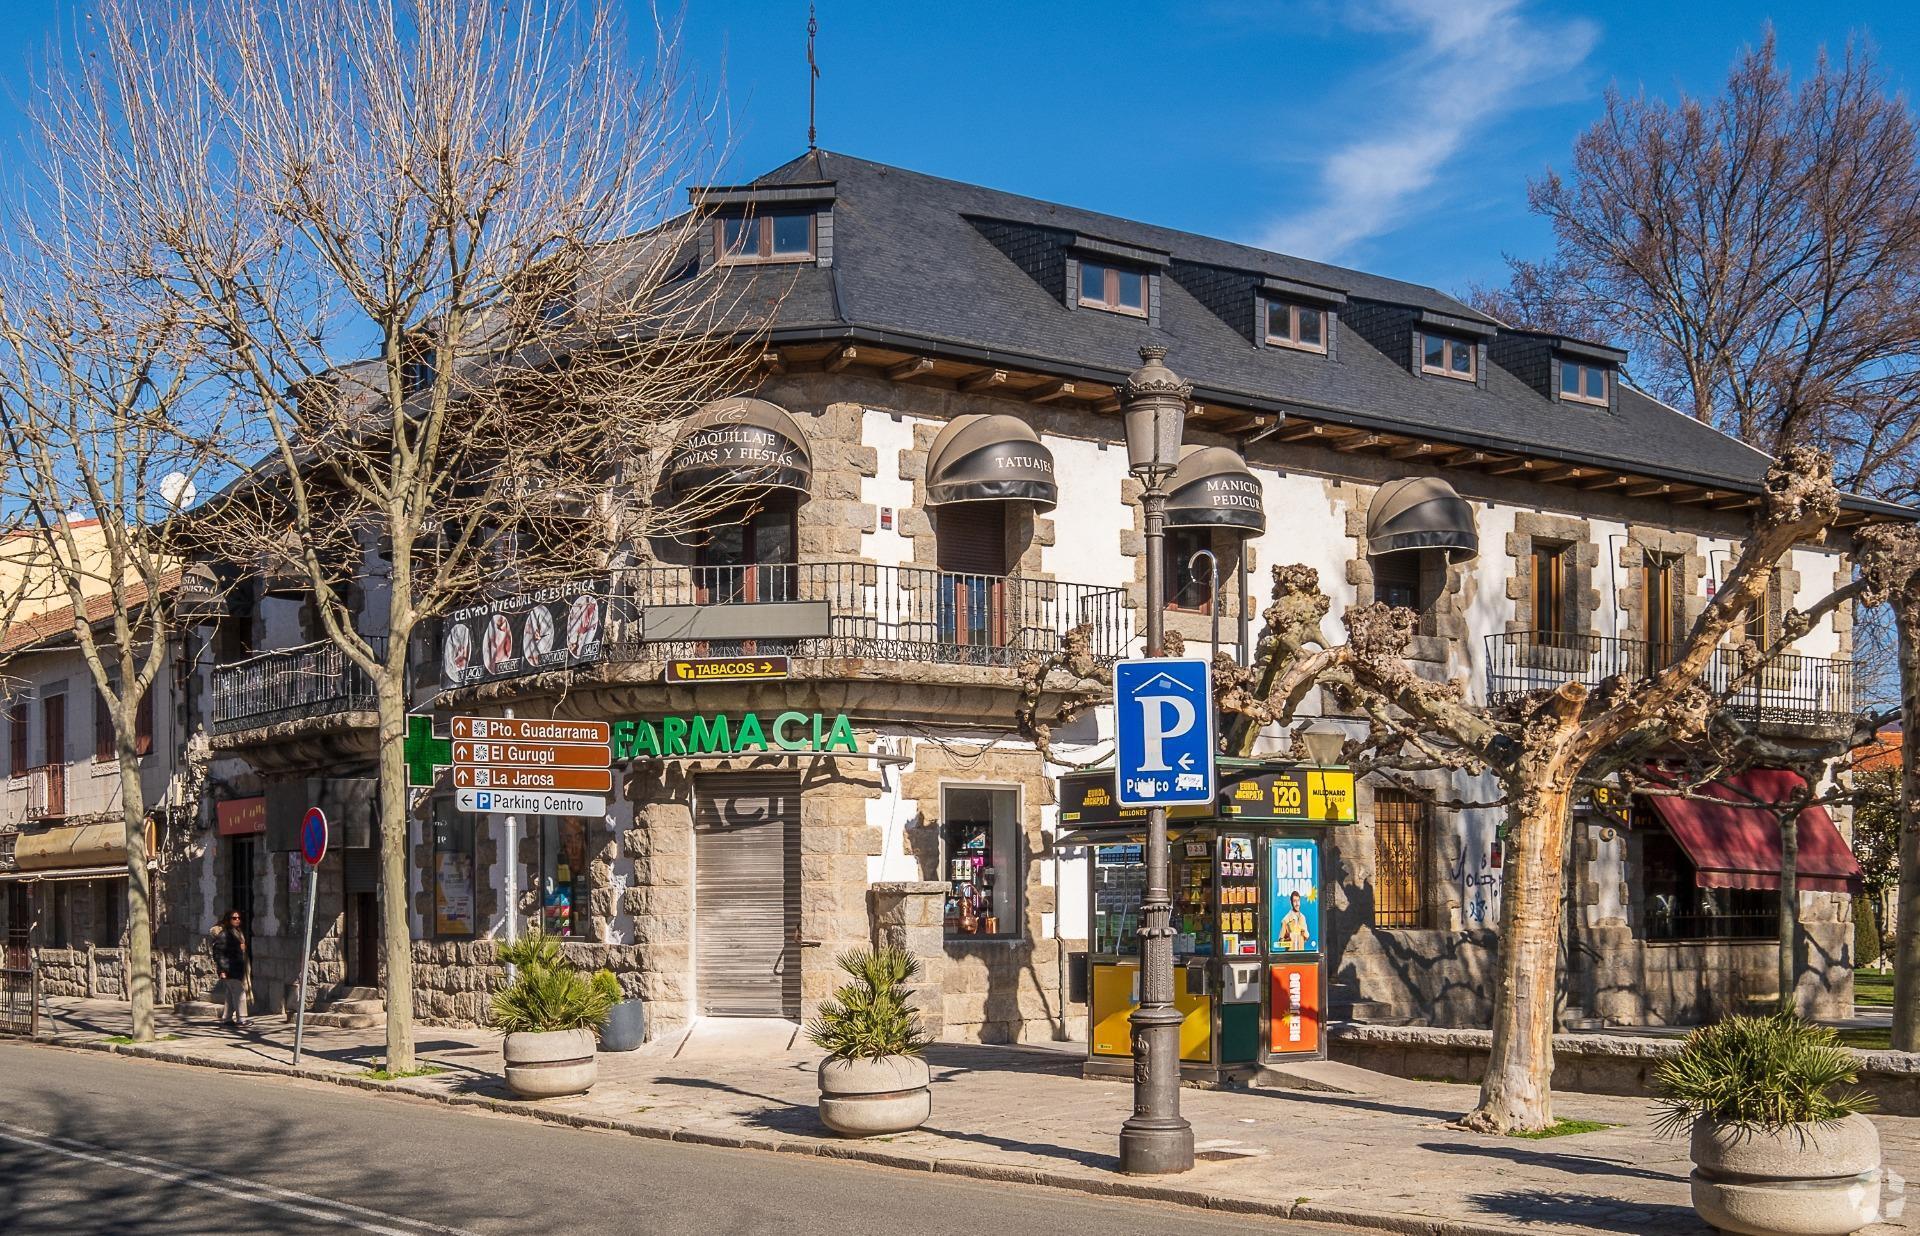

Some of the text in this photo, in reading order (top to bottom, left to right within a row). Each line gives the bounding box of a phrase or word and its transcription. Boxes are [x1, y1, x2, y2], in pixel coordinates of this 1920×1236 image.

[688, 432, 775, 450] MAQUILLAJE
[724, 448, 734, 458] Y
[740, 447, 793, 467] FIESTAS
[995, 456, 1052, 473] TATUAJES
[696, 662, 755, 675] TABACOS
[490, 721, 599, 740] Pto. Guadarrama
[613, 711, 859, 760] FARMACIA
[1134, 695, 1196, 772] P
[491, 745, 555, 765] El Gurugú
[492, 770, 554, 786] La Jarosa
[494, 794, 539, 812] Parking
[544, 796, 584, 811] Centro
[1271, 786, 1301, 807] 120
[1119, 808, 1147, 817] MILLONES
[1273, 807, 1301, 815] MILLONES
[1276, 848, 1313, 879] BIEN
